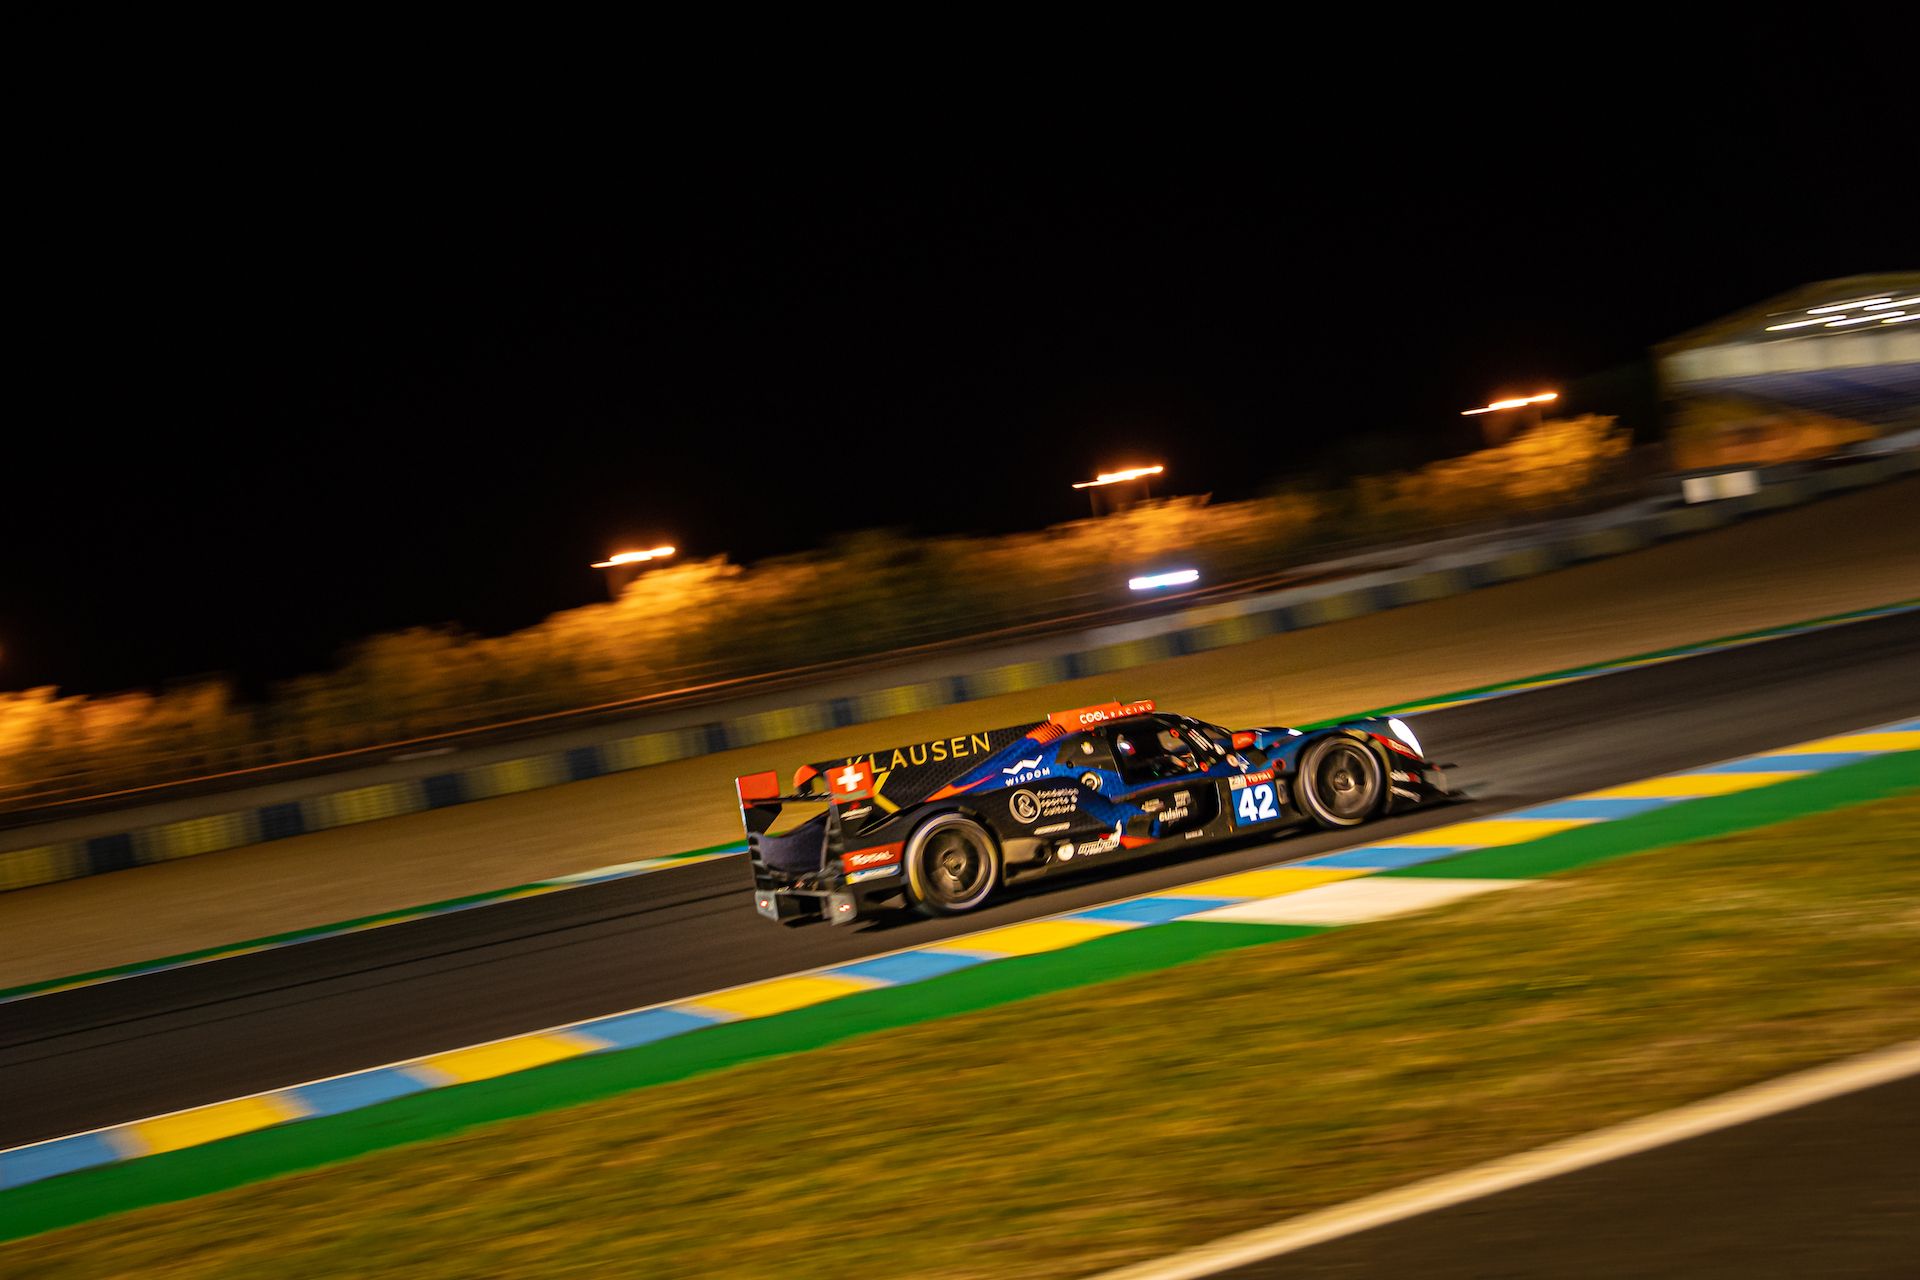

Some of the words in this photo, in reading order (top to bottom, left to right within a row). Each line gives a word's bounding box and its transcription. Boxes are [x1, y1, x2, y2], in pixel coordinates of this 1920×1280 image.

[1080, 710, 1109, 724] COOL
[1110, 704, 1153, 719] RACING
[1005, 767, 1050, 787] WISDOM
[1238, 784, 1277, 821] 42
